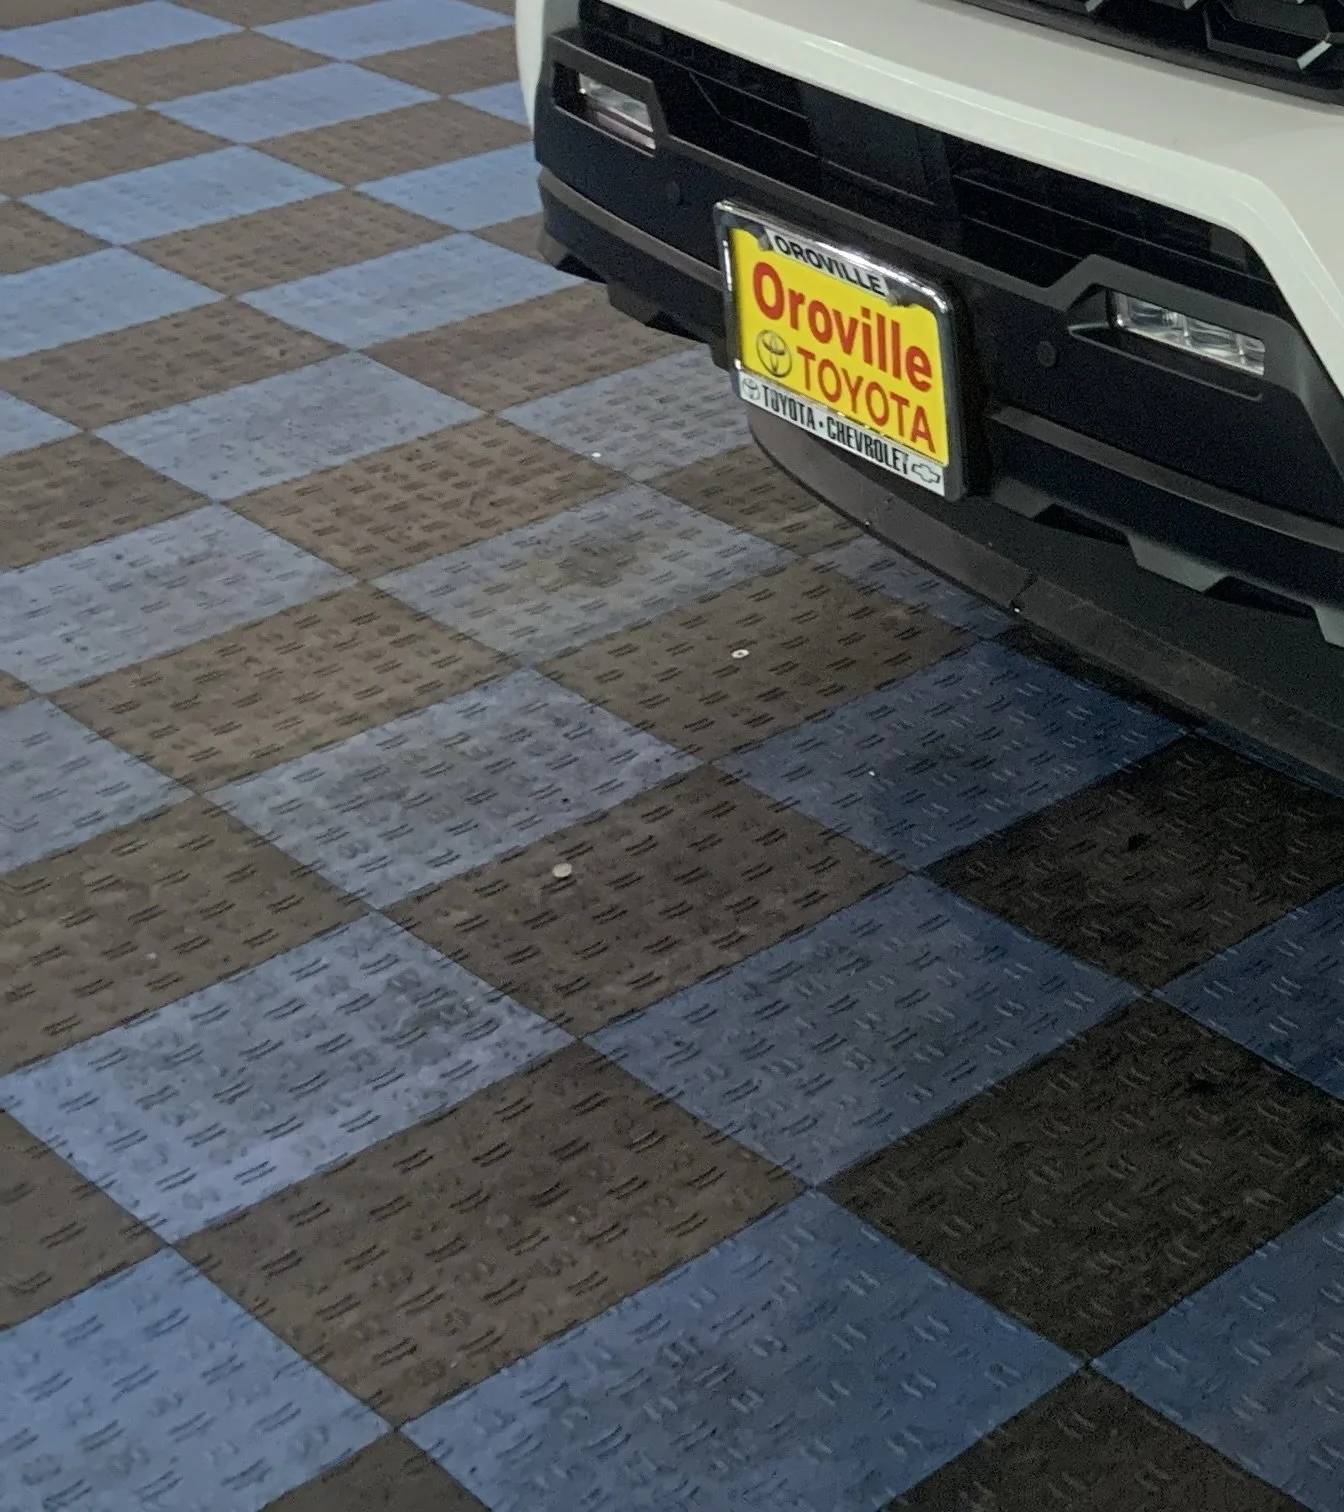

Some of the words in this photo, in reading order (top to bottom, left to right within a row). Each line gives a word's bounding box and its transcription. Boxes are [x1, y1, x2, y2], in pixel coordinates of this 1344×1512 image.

[773, 235, 888, 296] OROVILLE
[753, 261, 932, 393] Oroville
[761, 385, 817, 429] TOYOTA
[826, 417, 911, 476] CHEVROLET
[796, 345, 936, 454] TOYOTA
